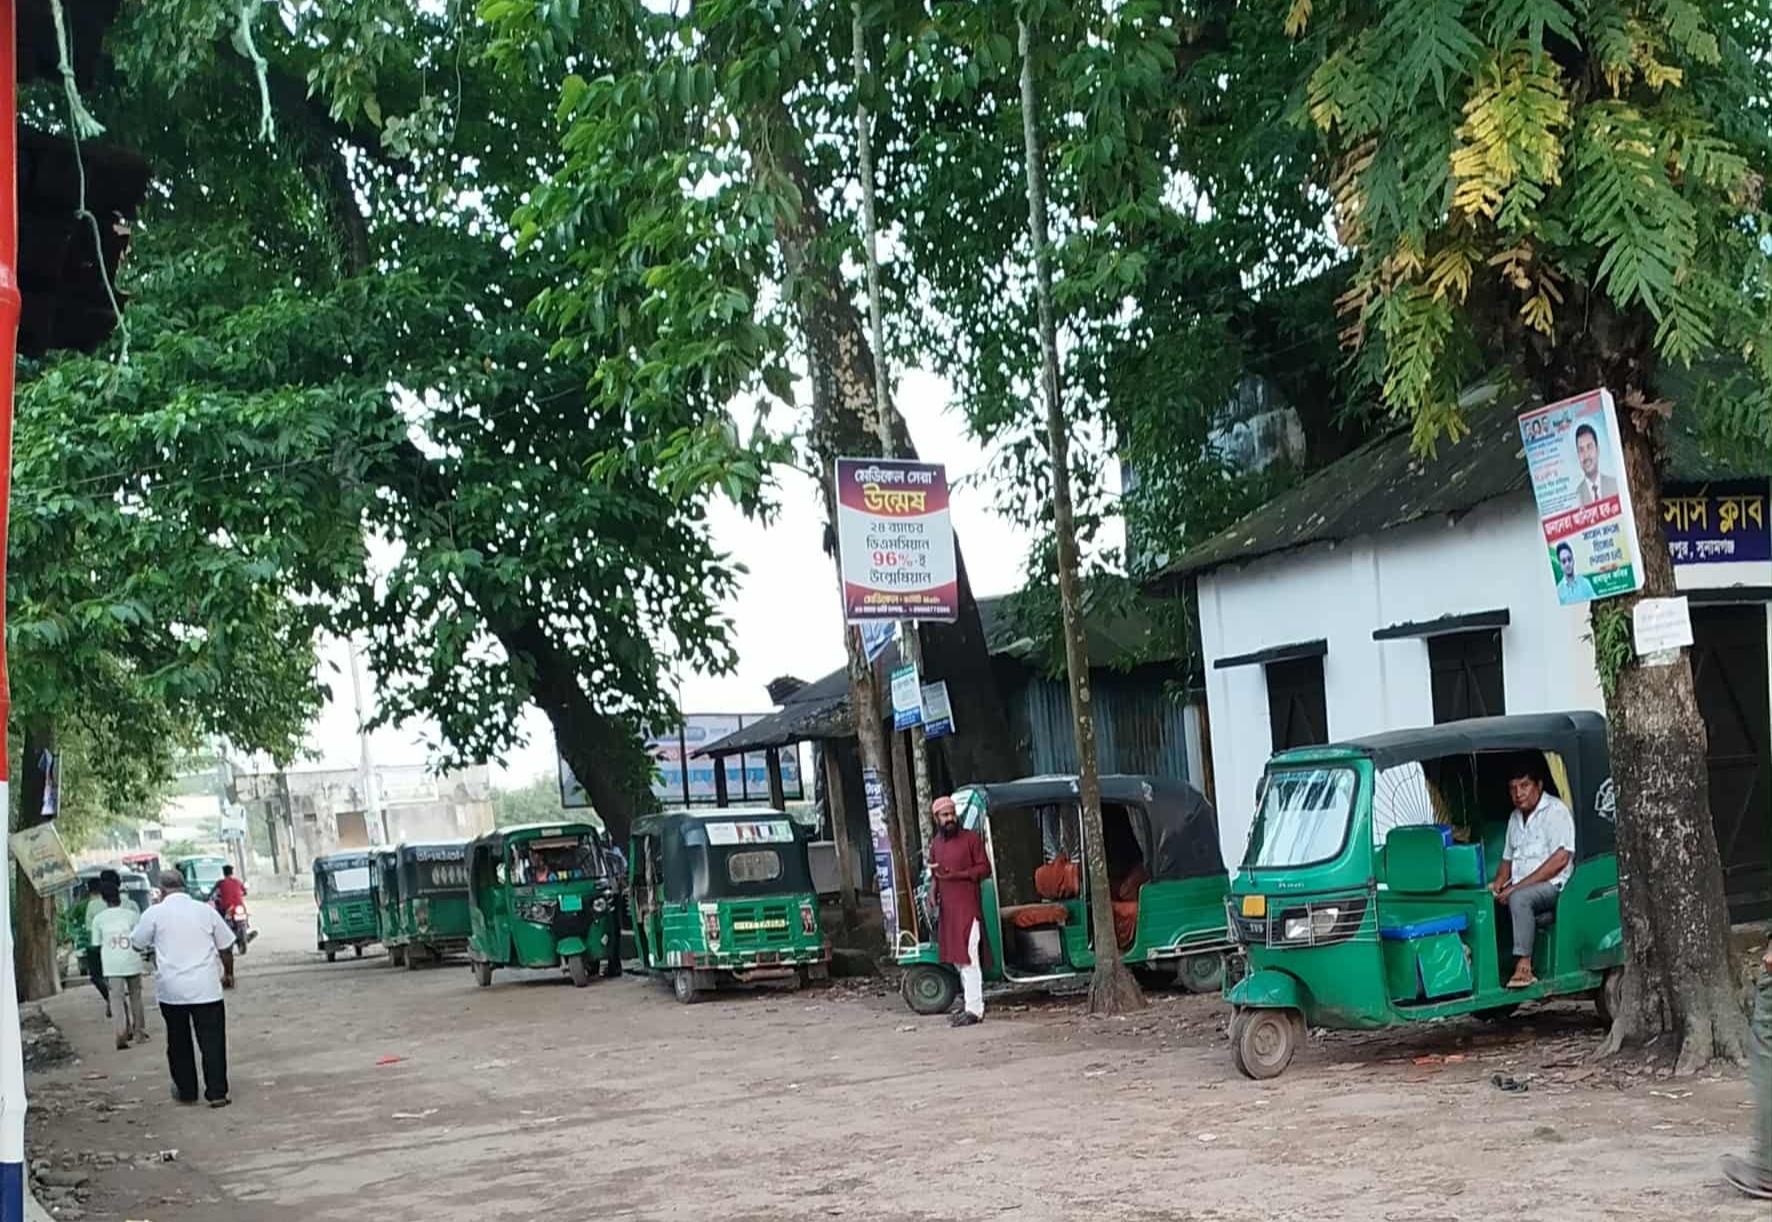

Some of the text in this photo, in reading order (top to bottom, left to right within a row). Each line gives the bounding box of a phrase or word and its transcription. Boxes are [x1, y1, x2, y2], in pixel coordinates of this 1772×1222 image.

[854, 465, 904, 483] মেডিকেল
[863, 483, 927, 513] উন্মেষ
[1715, 494, 1764, 533] ক্লাব
[871, 522, 924, 533] ২৪ ব্যাচের
